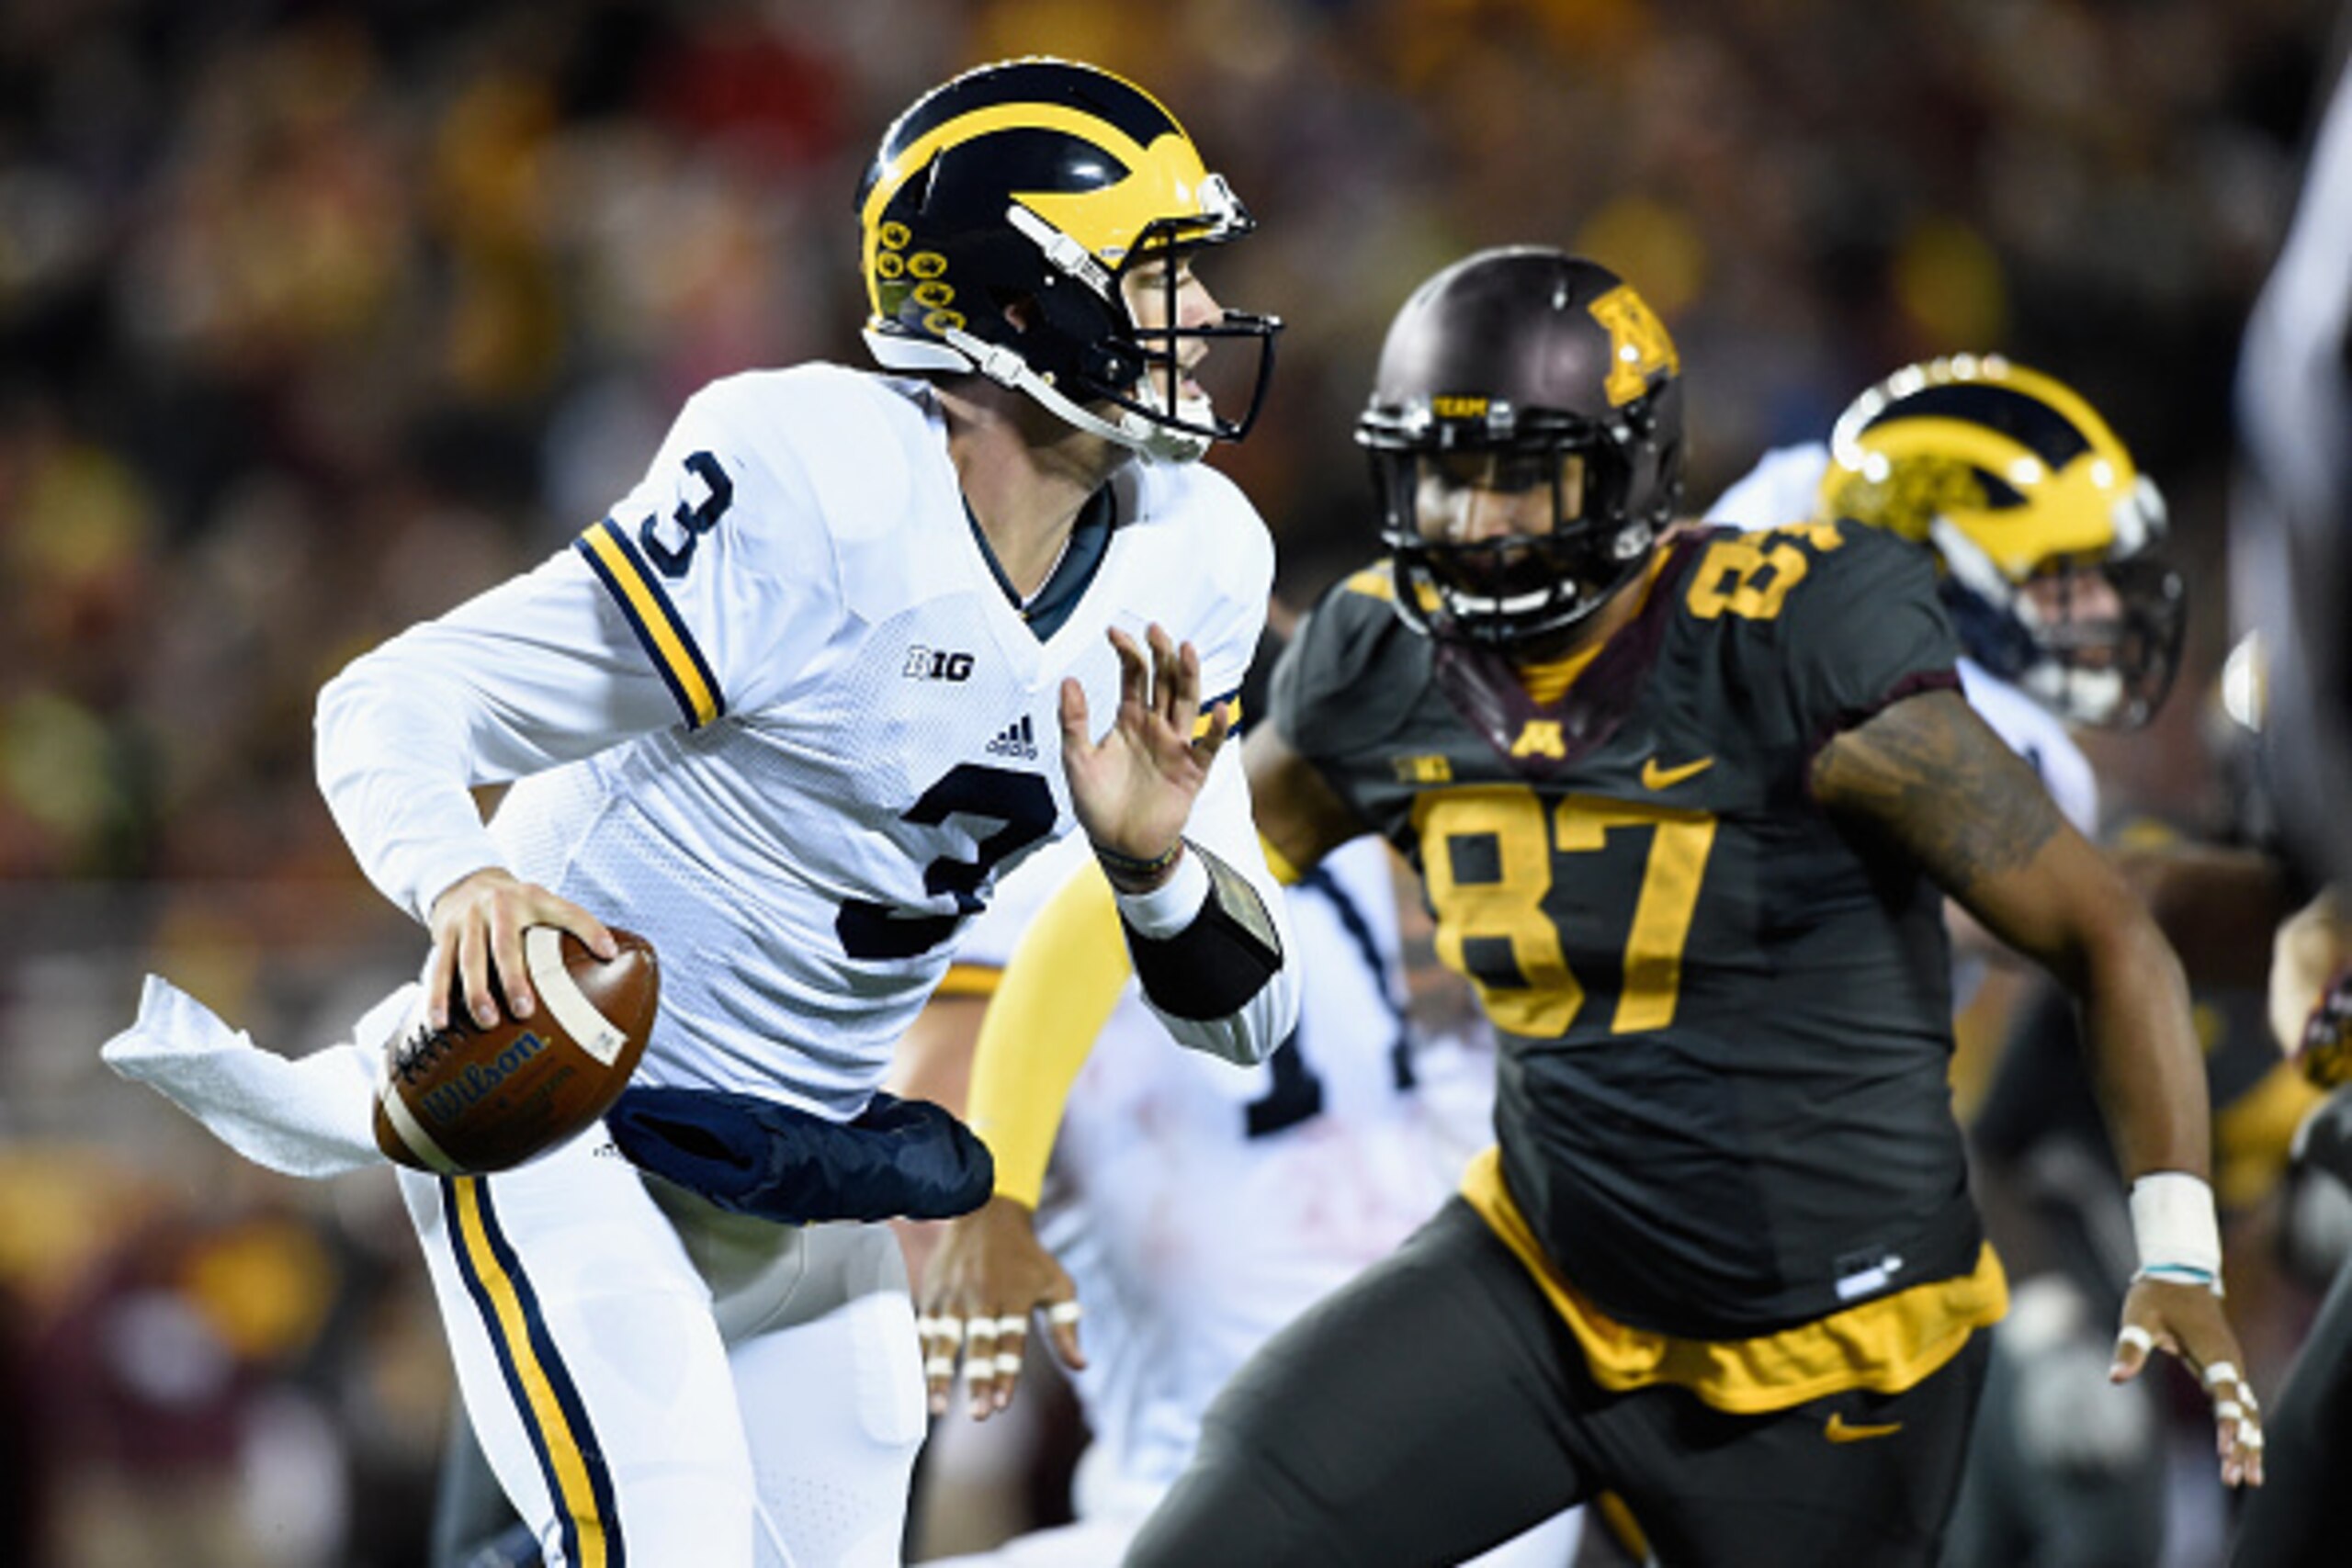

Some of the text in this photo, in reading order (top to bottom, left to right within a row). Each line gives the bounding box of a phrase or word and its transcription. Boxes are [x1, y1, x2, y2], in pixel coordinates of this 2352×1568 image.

[639, 451, 732, 578] 3
[1511, 719, 1566, 759] M
[835, 763, 1058, 959] 3
[1410, 783, 1718, 1039] 87
[422, 1030, 548, 1124] Wilson
